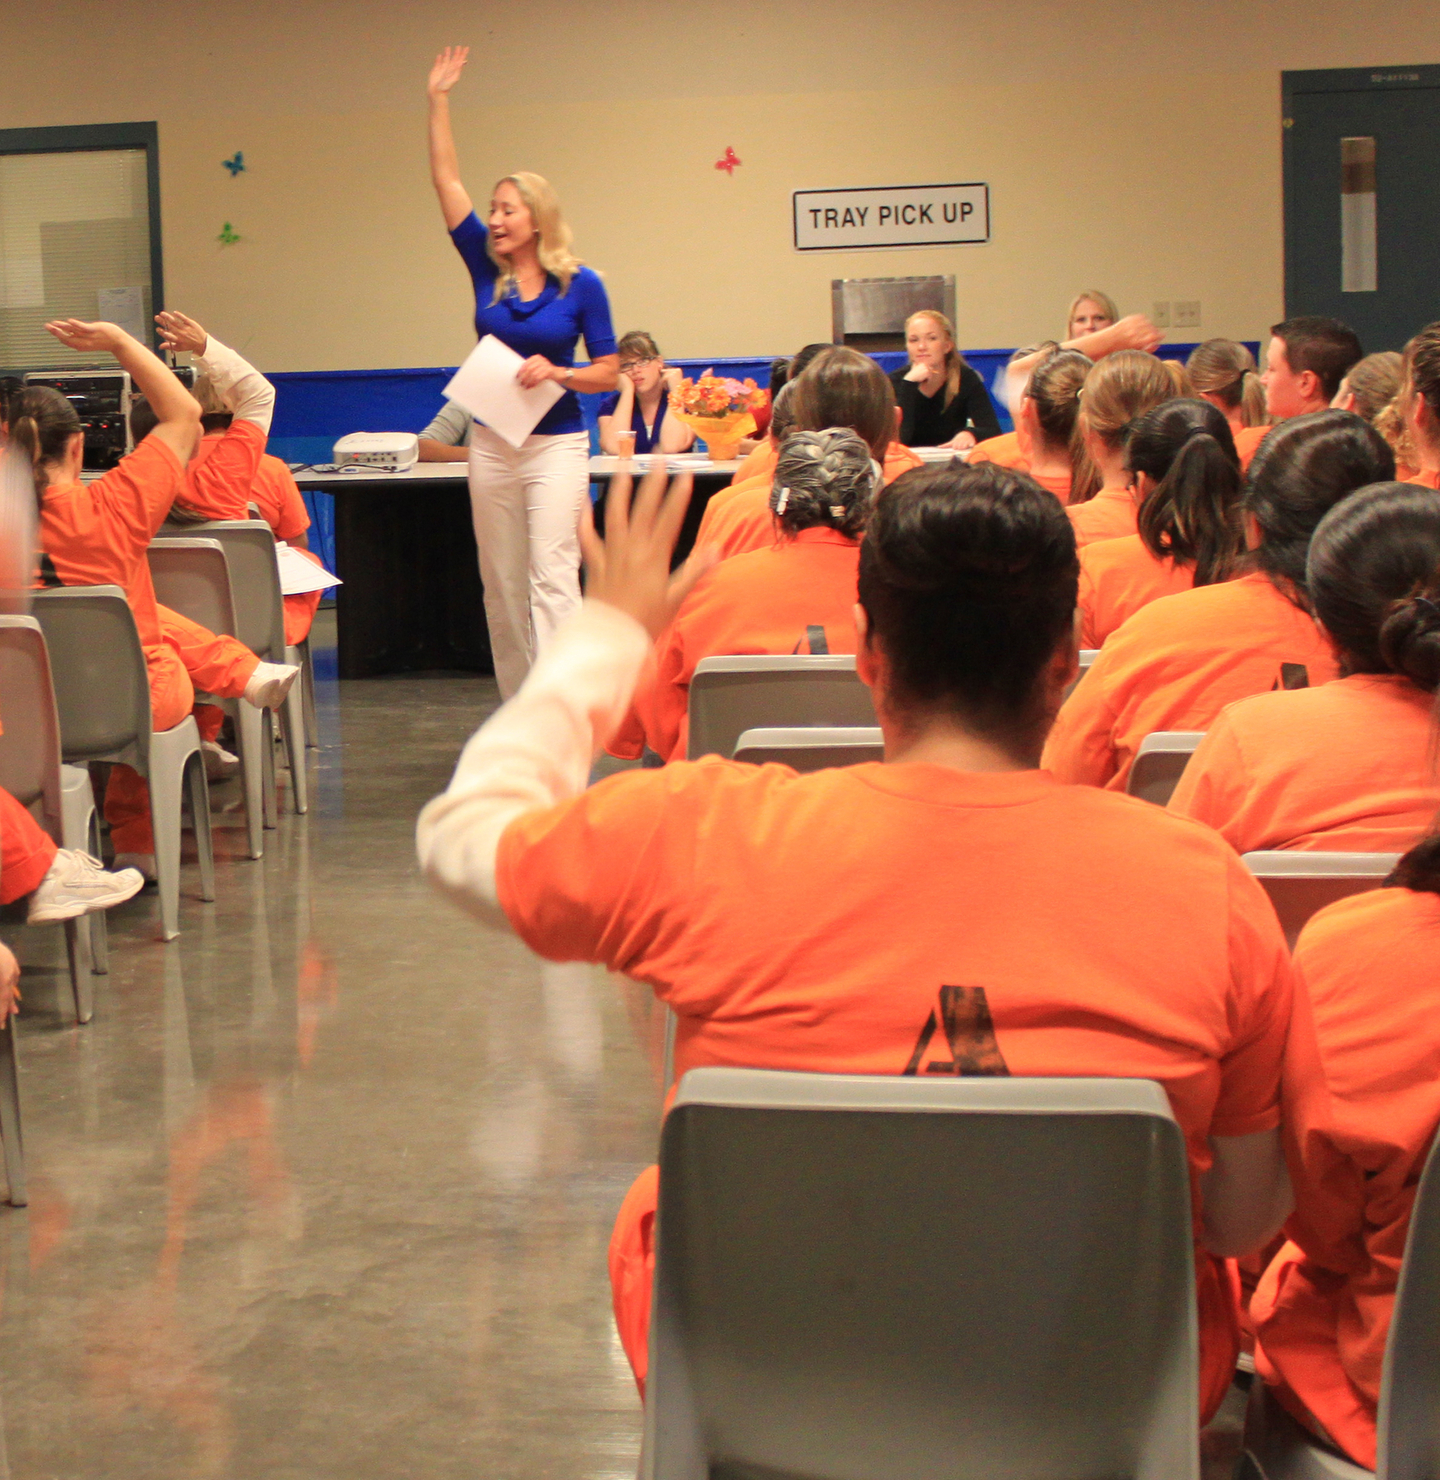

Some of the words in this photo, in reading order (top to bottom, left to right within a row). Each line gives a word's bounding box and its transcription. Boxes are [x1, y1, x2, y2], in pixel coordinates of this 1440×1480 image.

[809, 206, 869, 229] TRAY
[878, 203, 934, 226] PICK
[943, 201, 973, 223] UP
[902, 985, 1011, 1077] A
